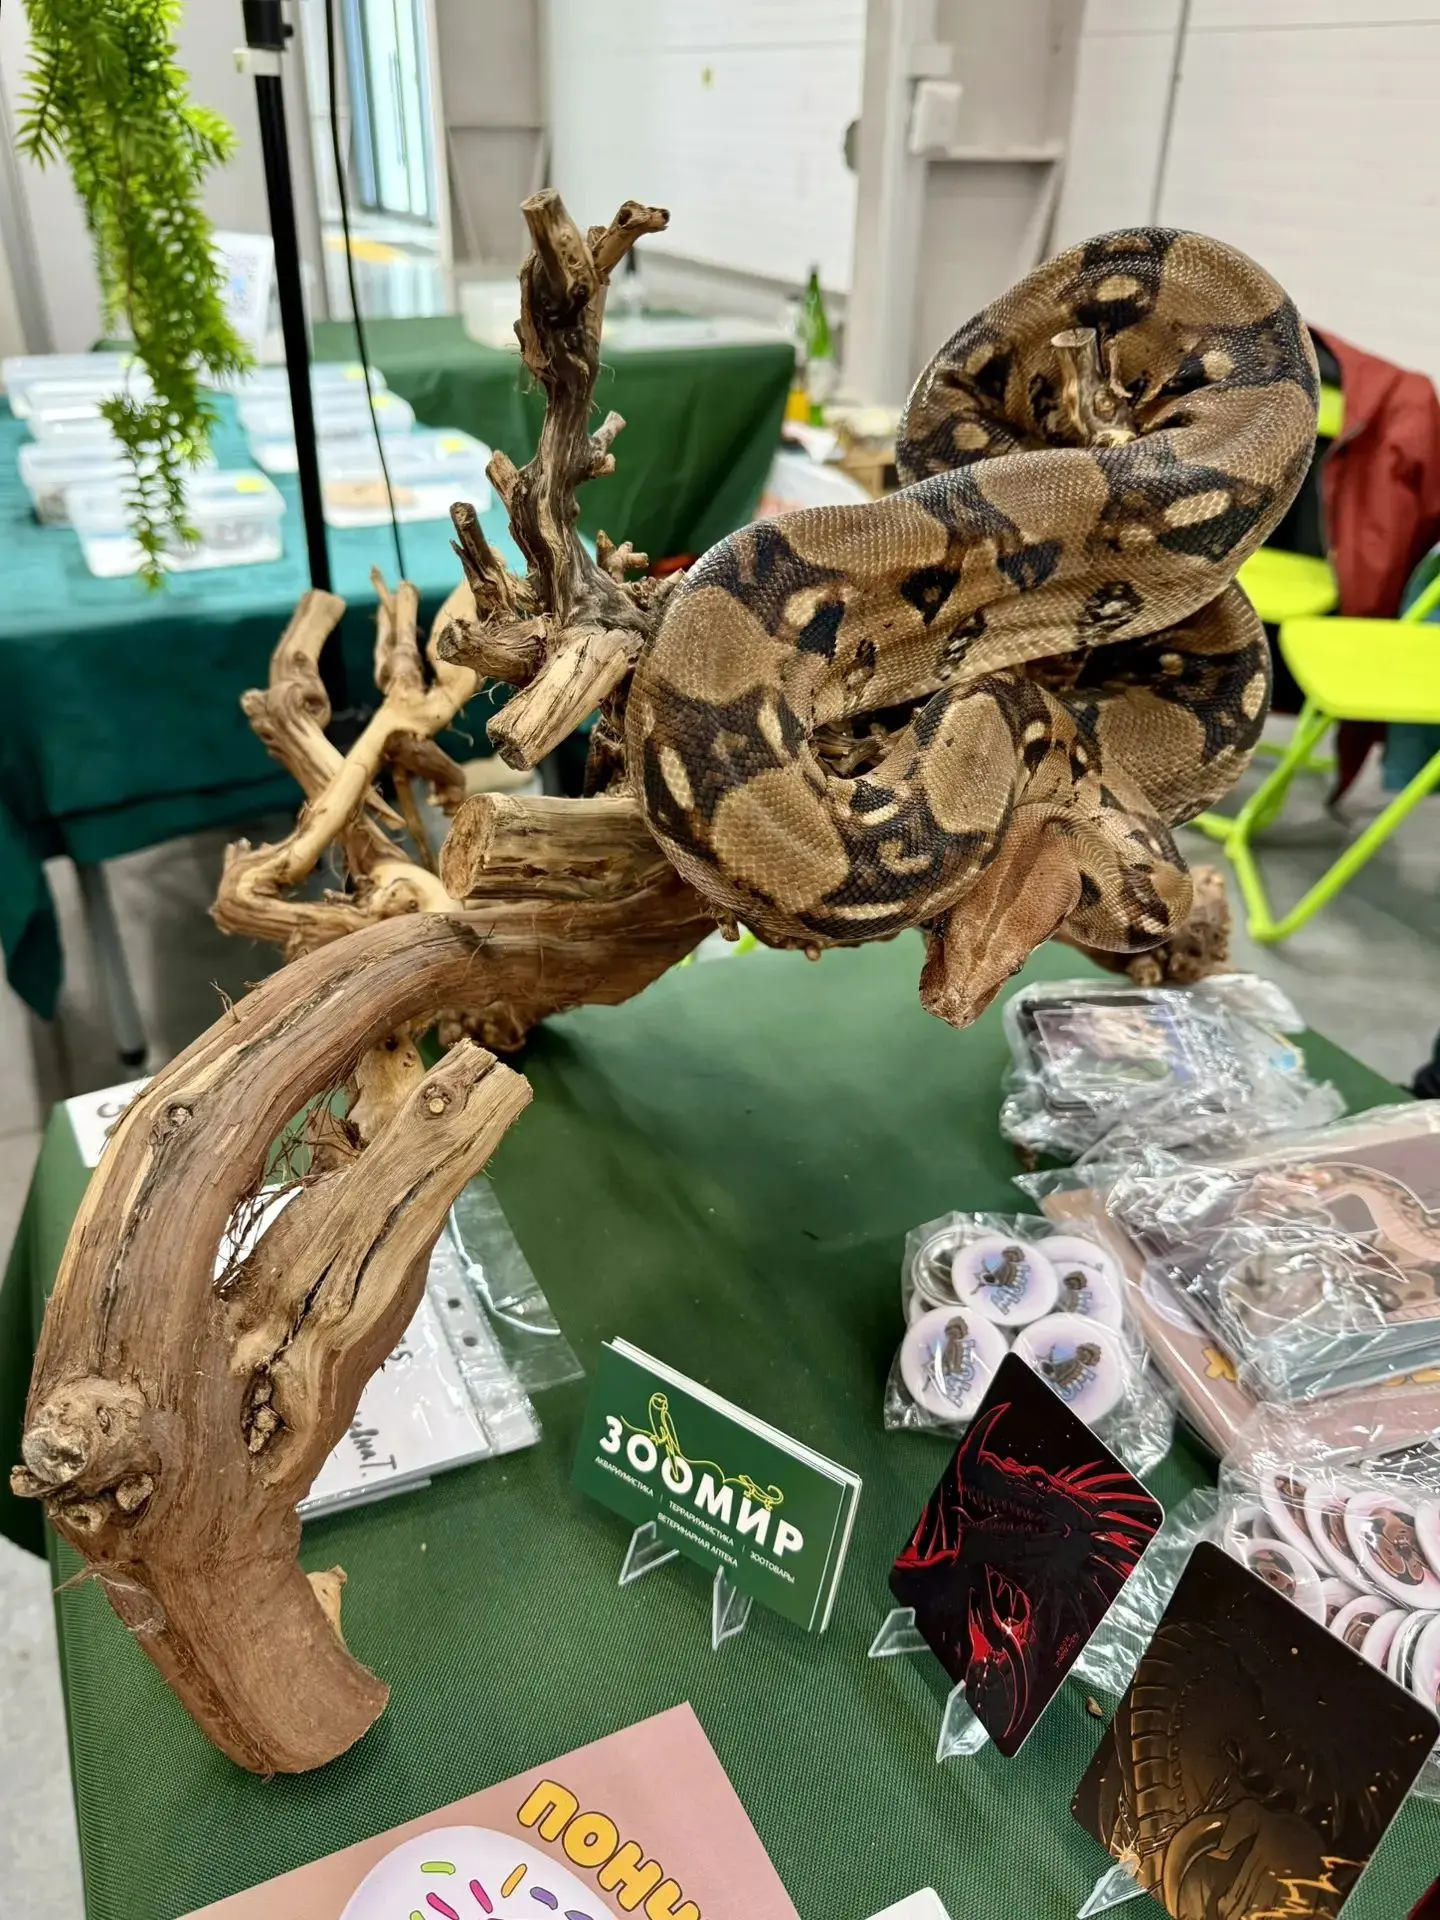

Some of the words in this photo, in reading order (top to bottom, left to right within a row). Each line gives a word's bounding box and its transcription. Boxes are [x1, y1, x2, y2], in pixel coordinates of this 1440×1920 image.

[594, 1455, 655, 1498] АКВАРИУМИСТИКА
[668, 1500, 735, 1547] ТЕРРАРИУМИСТИКА
[598, 1414, 805, 1558] ЗООМИР
[656, 1511, 712, 1552] ВЕТЕРИНАРНАЯ
[710, 1544, 739, 1569] АПТЕКА
[749, 1550, 796, 1585] ЗООТОВАРЫ
